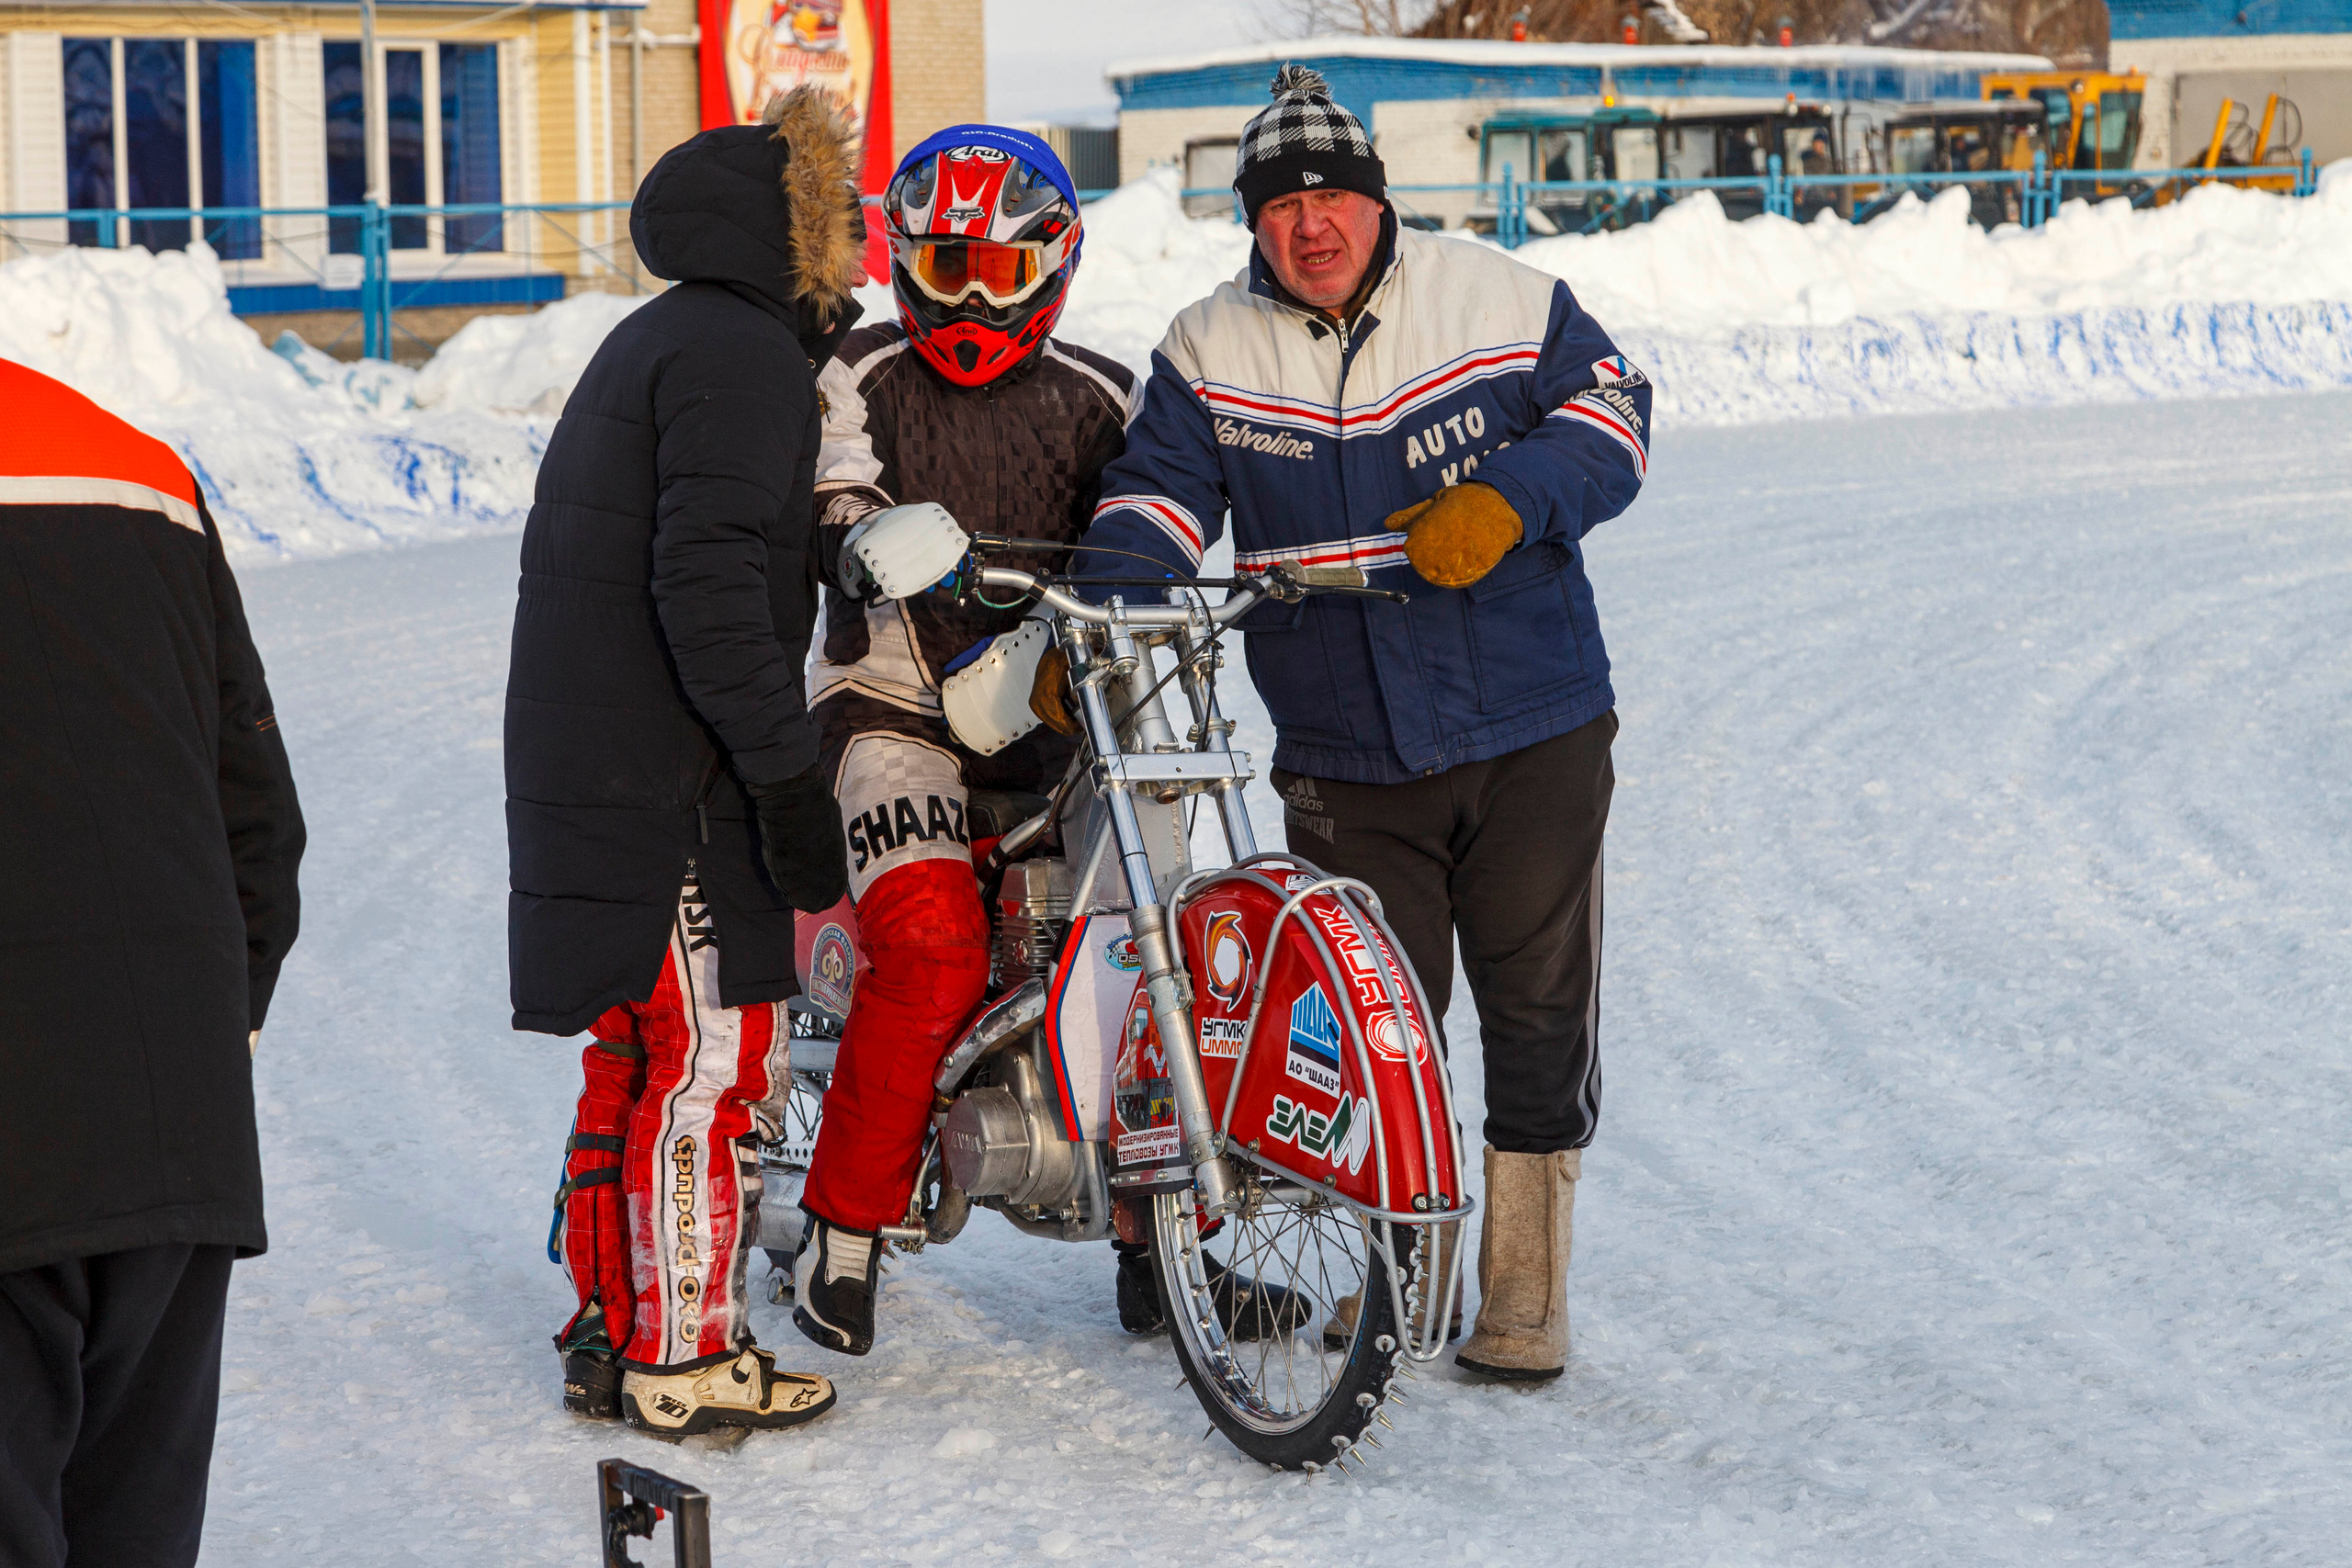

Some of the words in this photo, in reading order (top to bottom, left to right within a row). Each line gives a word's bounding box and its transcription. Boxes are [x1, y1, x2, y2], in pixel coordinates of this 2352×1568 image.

[952, 145, 1002, 158] Arai
[1406, 406, 1486, 469] AUTO
[1283, 793, 1324, 812] adidas
[848, 795, 970, 874] SHAAZ
[840, 935, 852, 976] ФАБРИКА
[1202, 1020, 1247, 1039] УГМК
[1288, 1059, 1303, 1076] АО
[1118, 1128, 1179, 1147] МОДЕРНИЗИРОВАННЫЕ
[1118, 1145, 1158, 1164] ТЕПЛОВОЗЫ
[1159, 1142, 1180, 1156] УГМК
